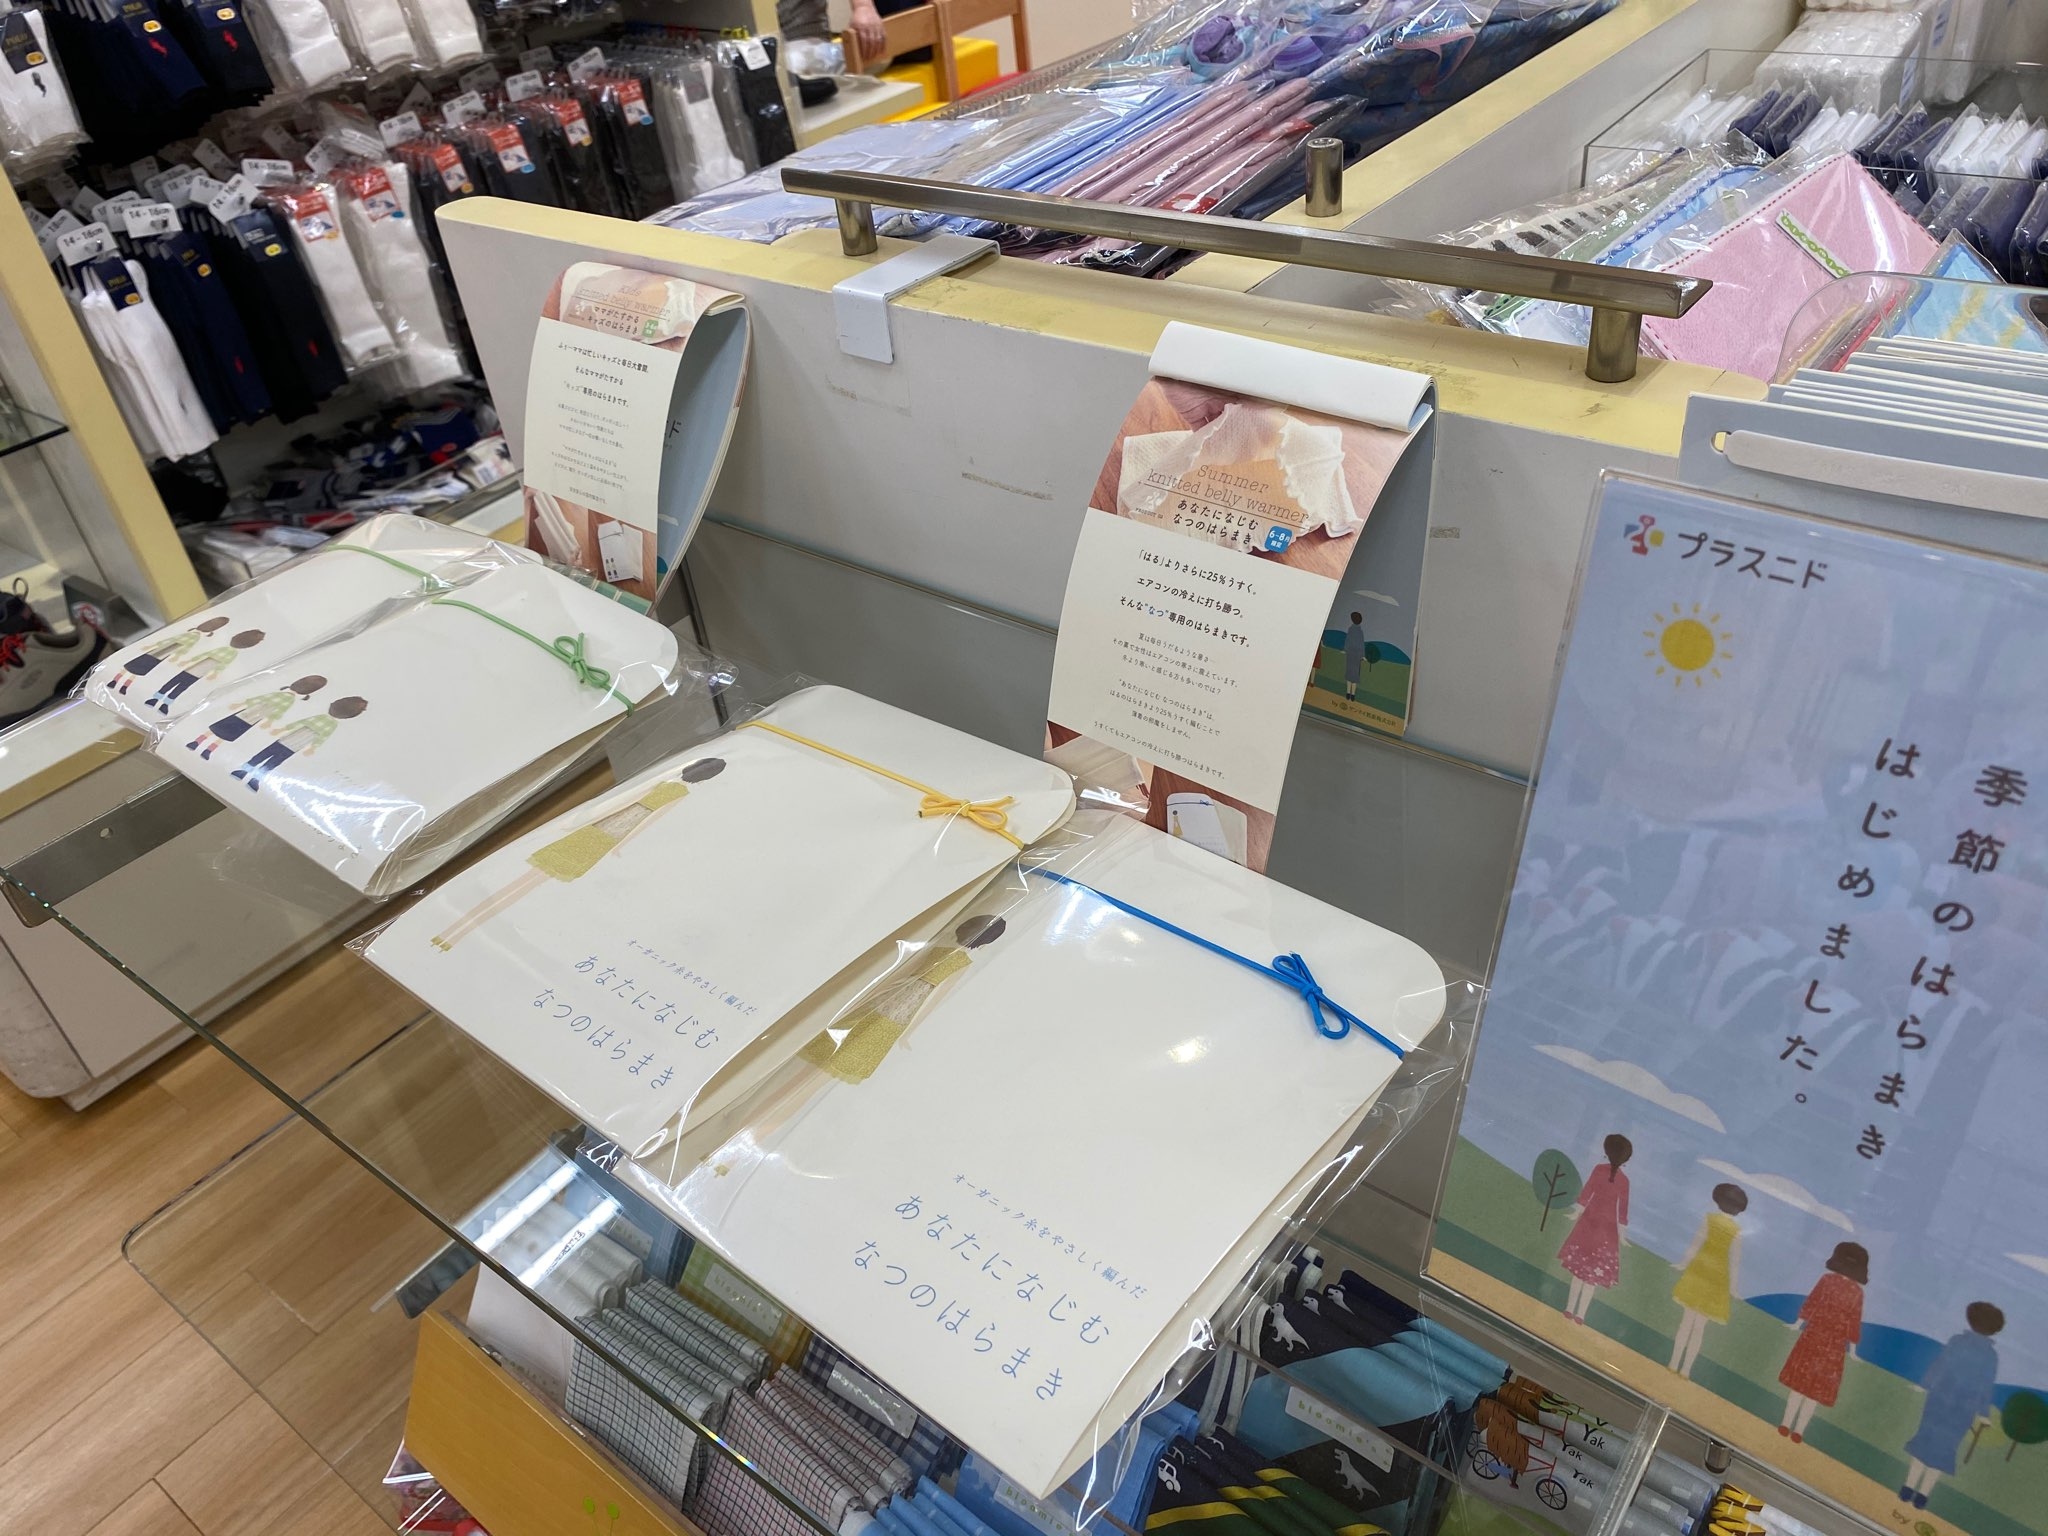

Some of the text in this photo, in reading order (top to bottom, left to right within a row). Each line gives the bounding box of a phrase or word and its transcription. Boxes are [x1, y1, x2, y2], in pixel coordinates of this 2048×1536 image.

[587, 315, 638, 335] キッズのはらまき
[575, 365, 624, 386] そんなママがたすかる
[1147, 469, 1310, 524] knitted belly warmer
[1197, 464, 1269, 494] Summer
[1173, 513, 1252, 545] なつのはらまき
[1177, 499, 1259, 531] あなたになじむ
[1677, 531, 1829, 589] プラスニド
[1137, 577, 1243, 618] エアコンの冷えに打ち勝つ。
[1780, 737, 1922, 1105] はじめました。
[627, 938, 758, 1017] オーガニック糸をやさしく編んだ
[1856, 764, 2029, 1160] 季節のはらまき
[574, 955, 719, 1049] あなたになじむ
[533, 988, 675, 1089] なつのはらまき
[953, 1173, 1148, 1300] オーガニック糸をやさしく編んだ
[894, 1194, 1109, 1345] あなたになじむ
[853, 1240, 1063, 1401] なつのはらまき
[1562, 1440, 1583, 1461] Yak
[1583, 1423, 1606, 1450] Yak
[1572, 1468, 1595, 1489] Yak
[1892, 1509, 1911, 1525] by
